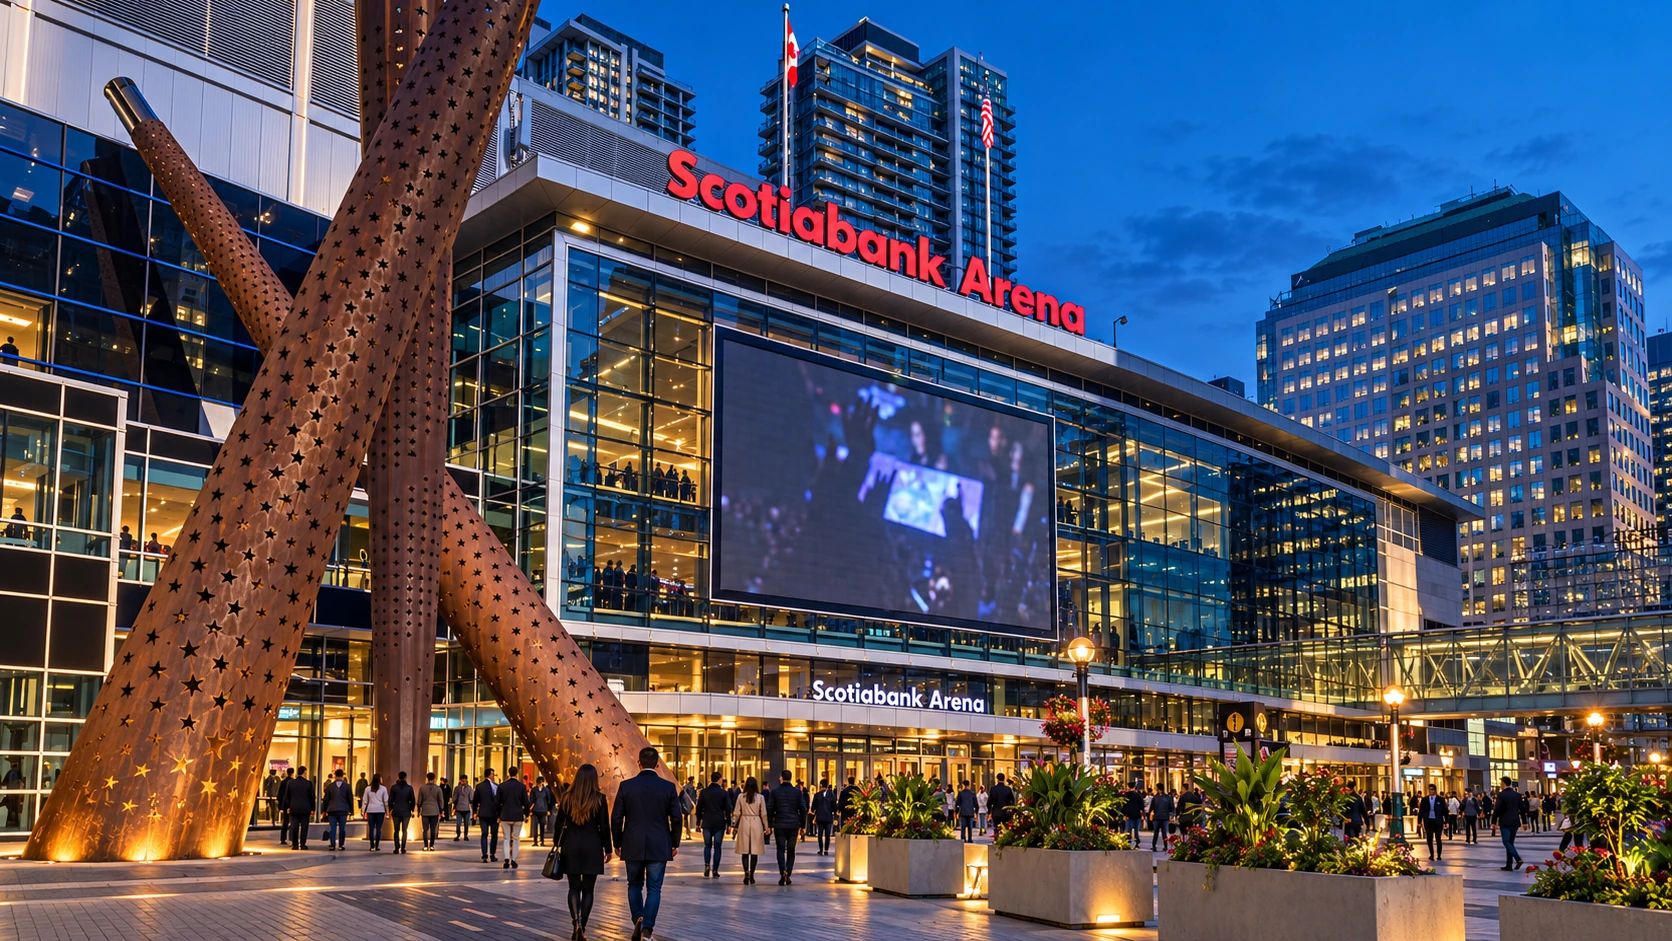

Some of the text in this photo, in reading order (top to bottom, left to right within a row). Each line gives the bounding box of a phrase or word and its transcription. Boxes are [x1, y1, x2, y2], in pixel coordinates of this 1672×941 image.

[667, 149, 1086, 336] Scotiabank Arena
[812, 679, 985, 713] Scotiabank Arena
